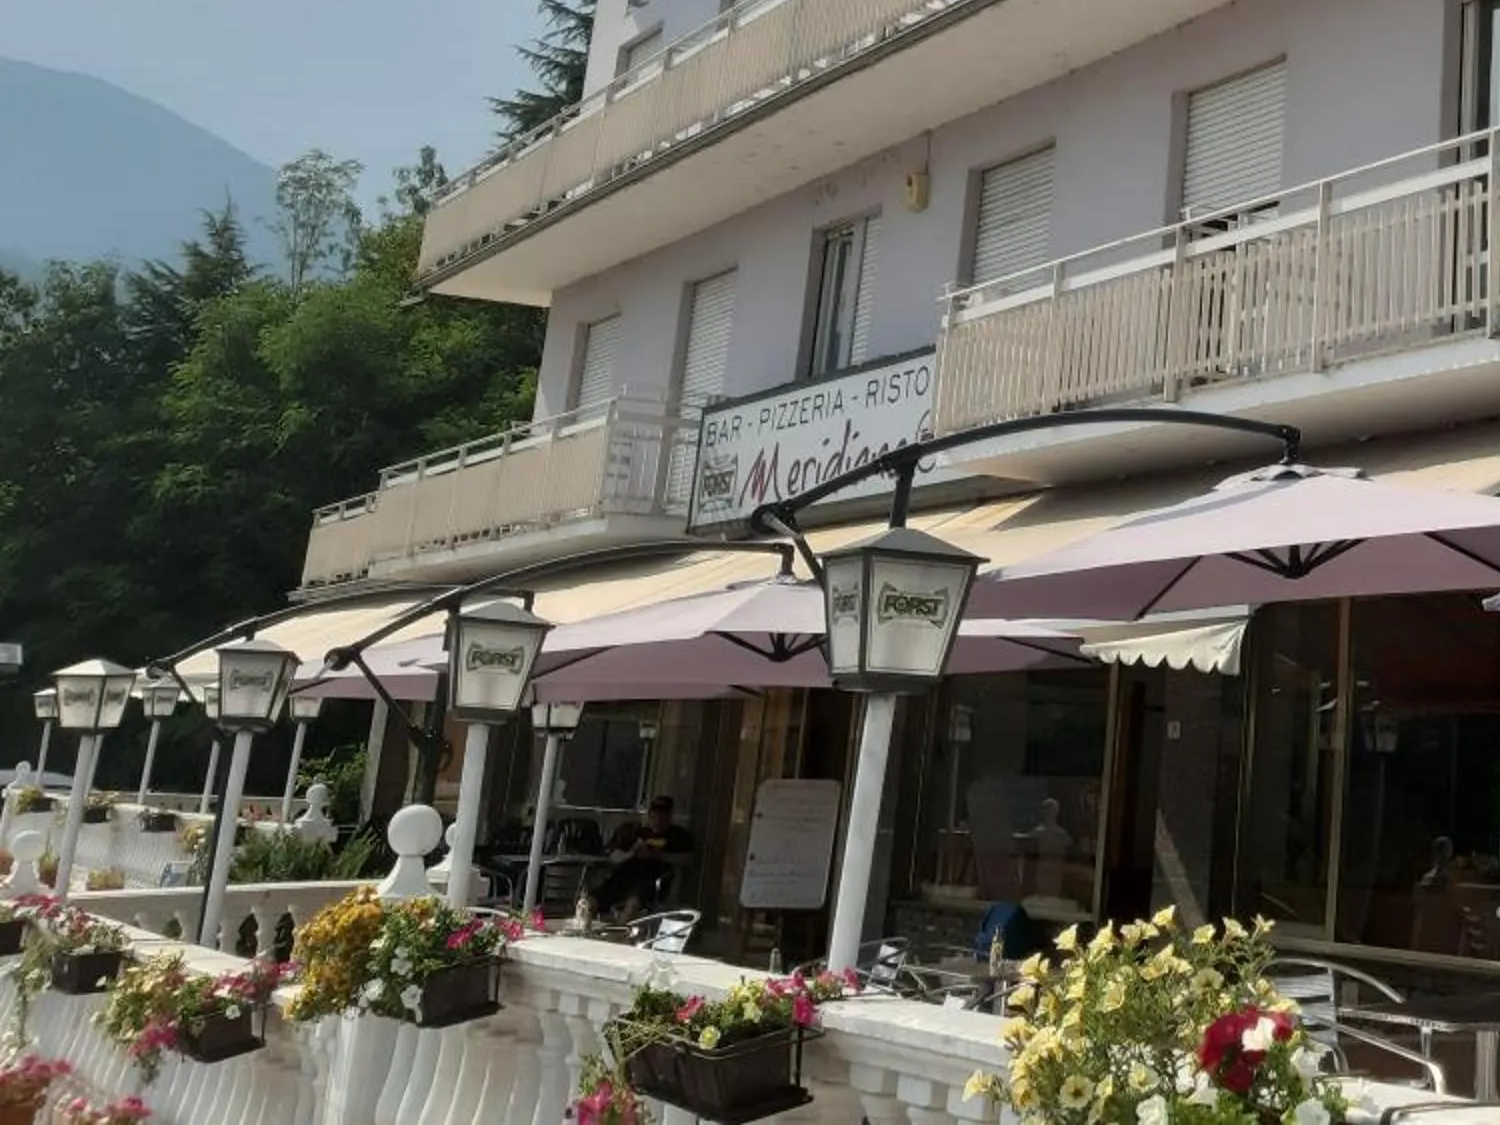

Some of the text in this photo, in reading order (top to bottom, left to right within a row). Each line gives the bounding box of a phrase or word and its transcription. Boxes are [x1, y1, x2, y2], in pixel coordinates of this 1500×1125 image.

[705, 415, 742, 447] BAR
[757, 388, 844, 436] PIZZERIA
[884, 594, 944, 616] FORST
